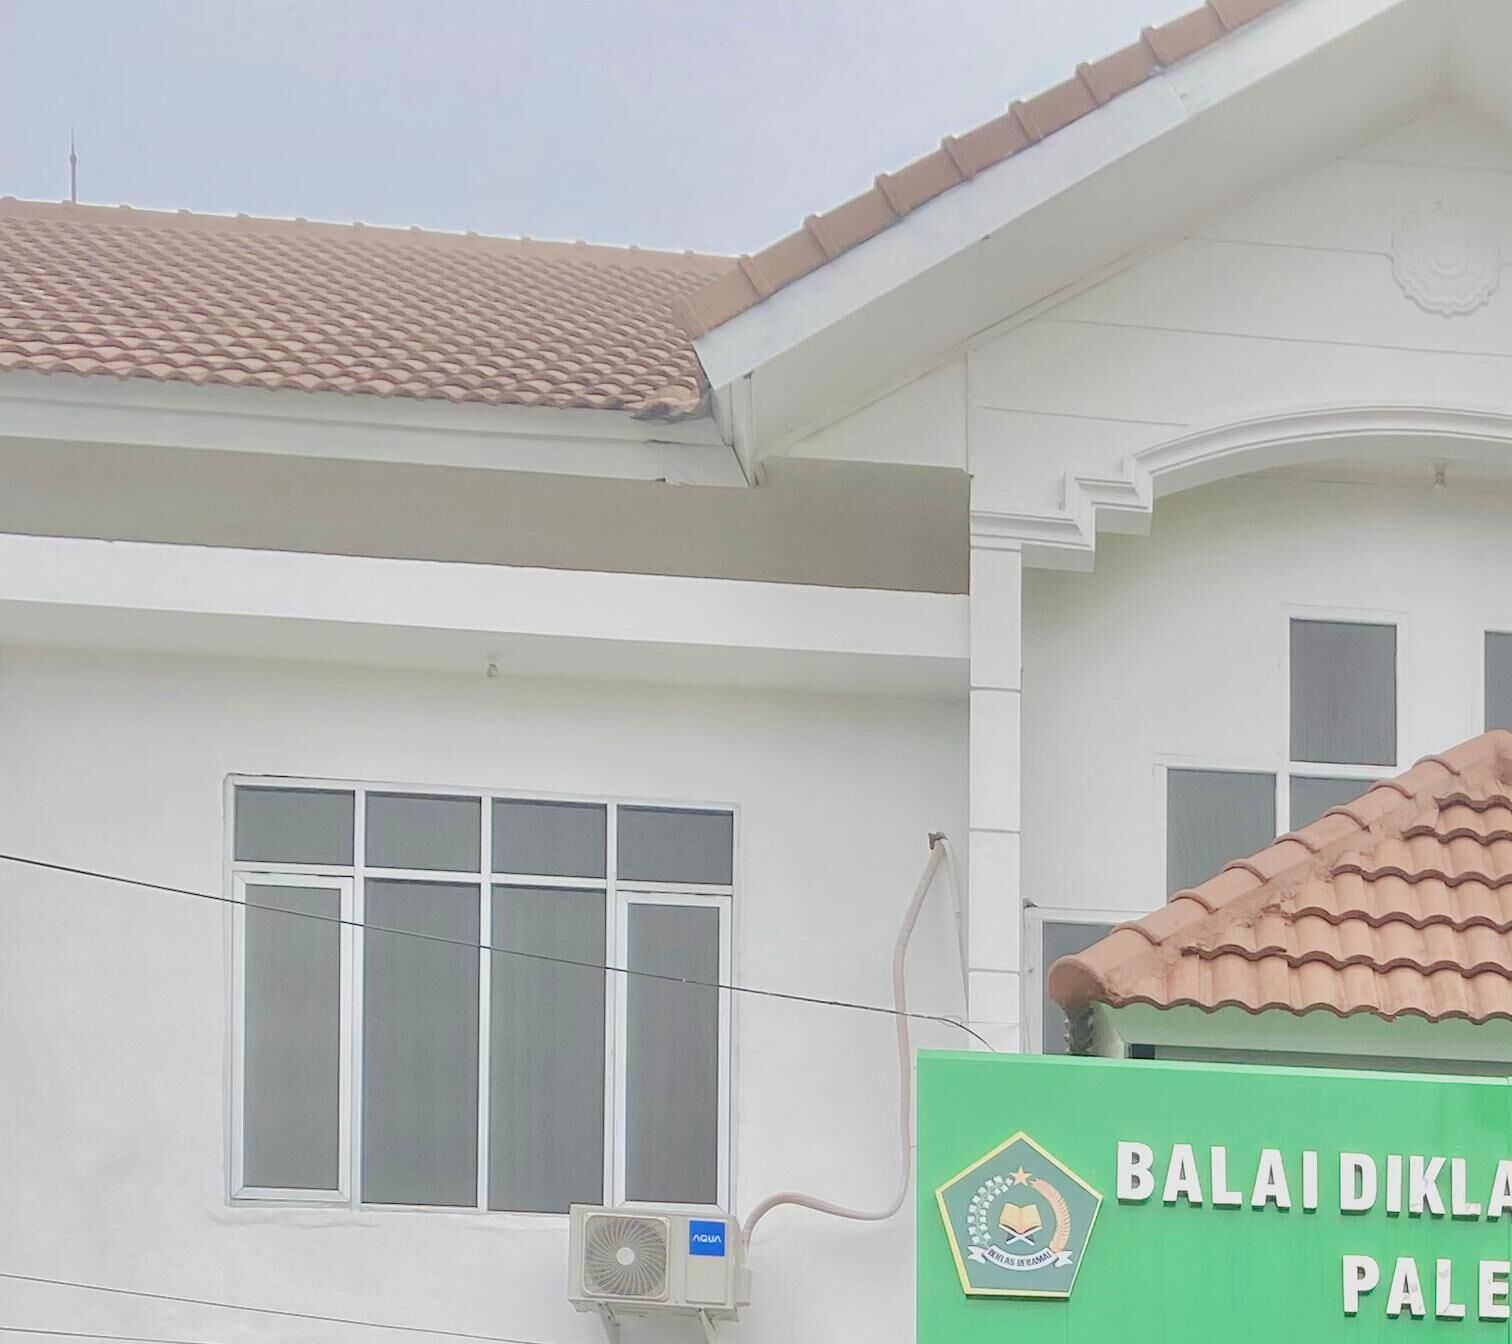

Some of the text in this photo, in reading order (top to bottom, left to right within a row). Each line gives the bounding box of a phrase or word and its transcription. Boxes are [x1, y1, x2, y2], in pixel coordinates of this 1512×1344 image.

[1116, 1141, 1318, 1210] BALAI
[692, 1234, 721, 1243] AQUA
[988, 1248, 1053, 1267] IKHLAS BERAMAL
